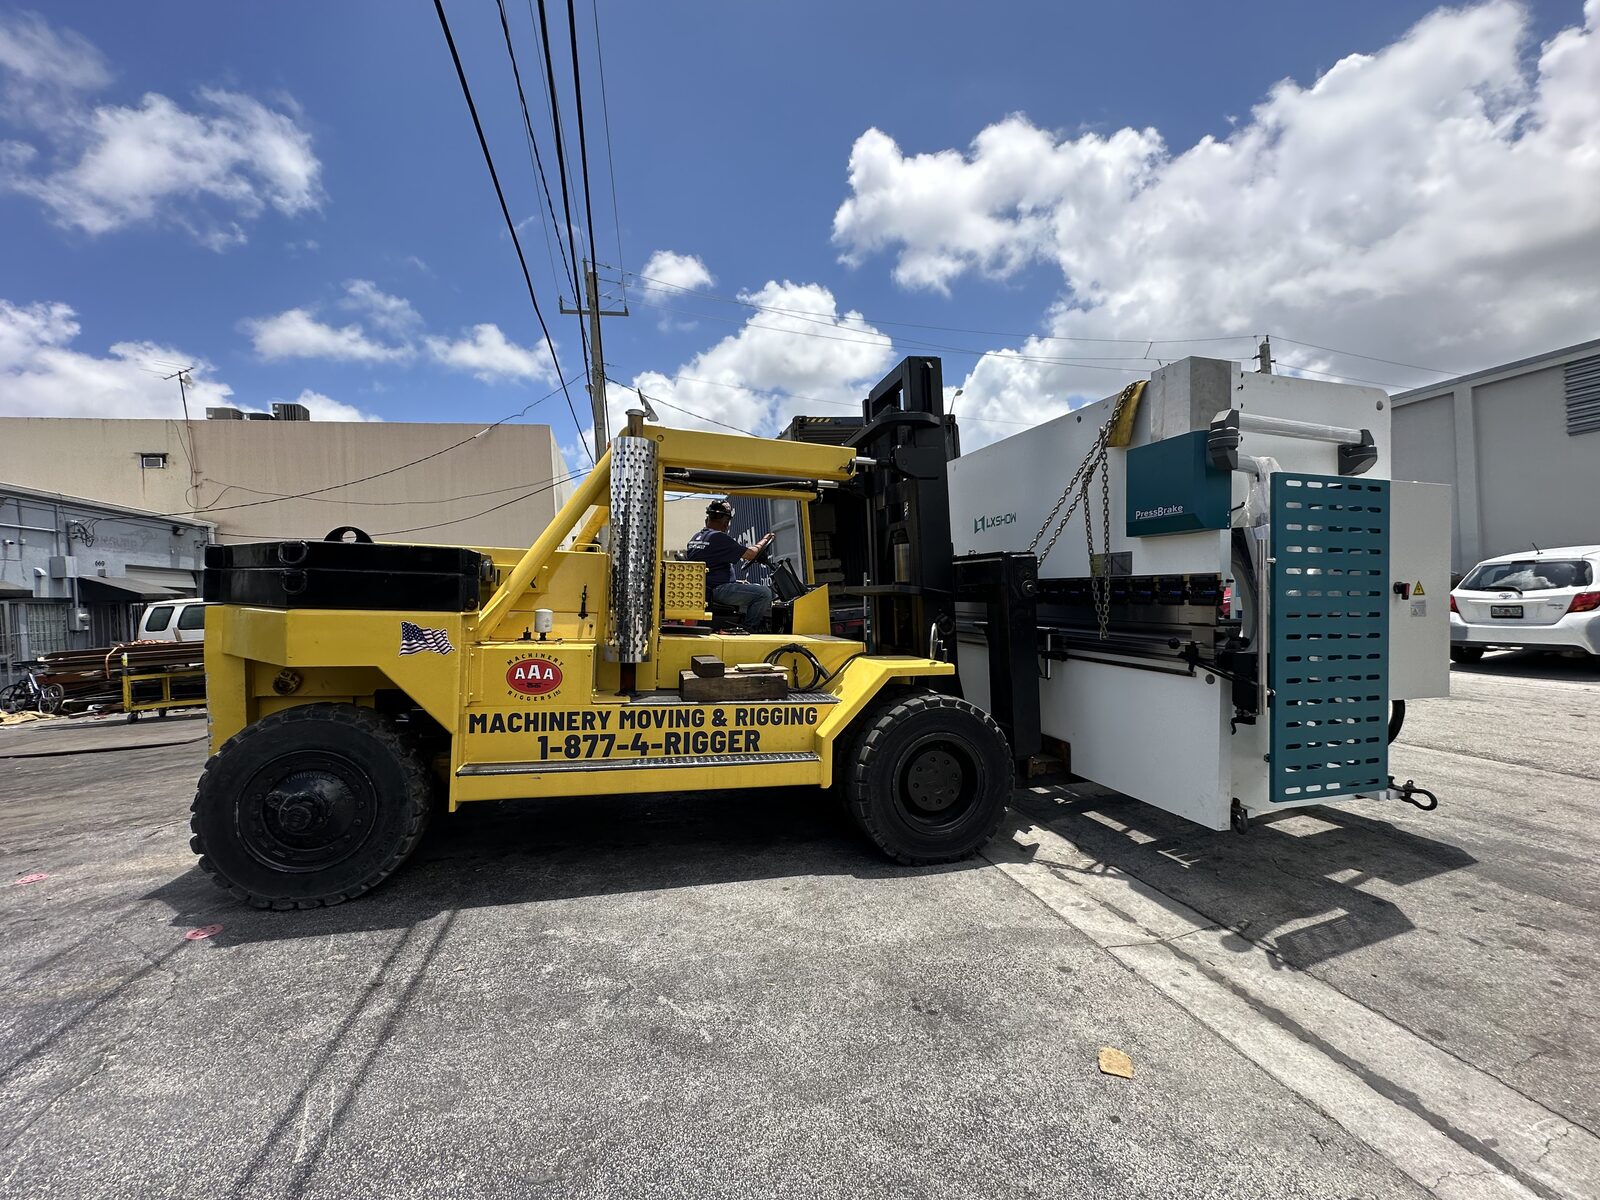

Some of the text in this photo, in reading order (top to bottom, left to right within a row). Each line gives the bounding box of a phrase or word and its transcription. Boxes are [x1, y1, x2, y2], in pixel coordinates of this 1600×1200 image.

[986, 512, 1017, 528] LXSHOW
[1135, 505, 1184, 520] PressBrake
[507, 653, 564, 667] MACHINERY
[515, 664, 554, 680] AAA
[507, 690, 552, 701] RIGGERS
[468, 707, 818, 734] MACHINERY MOVING & RIGGING
[537, 730, 761, 760] 1-877-4-RIGGER
